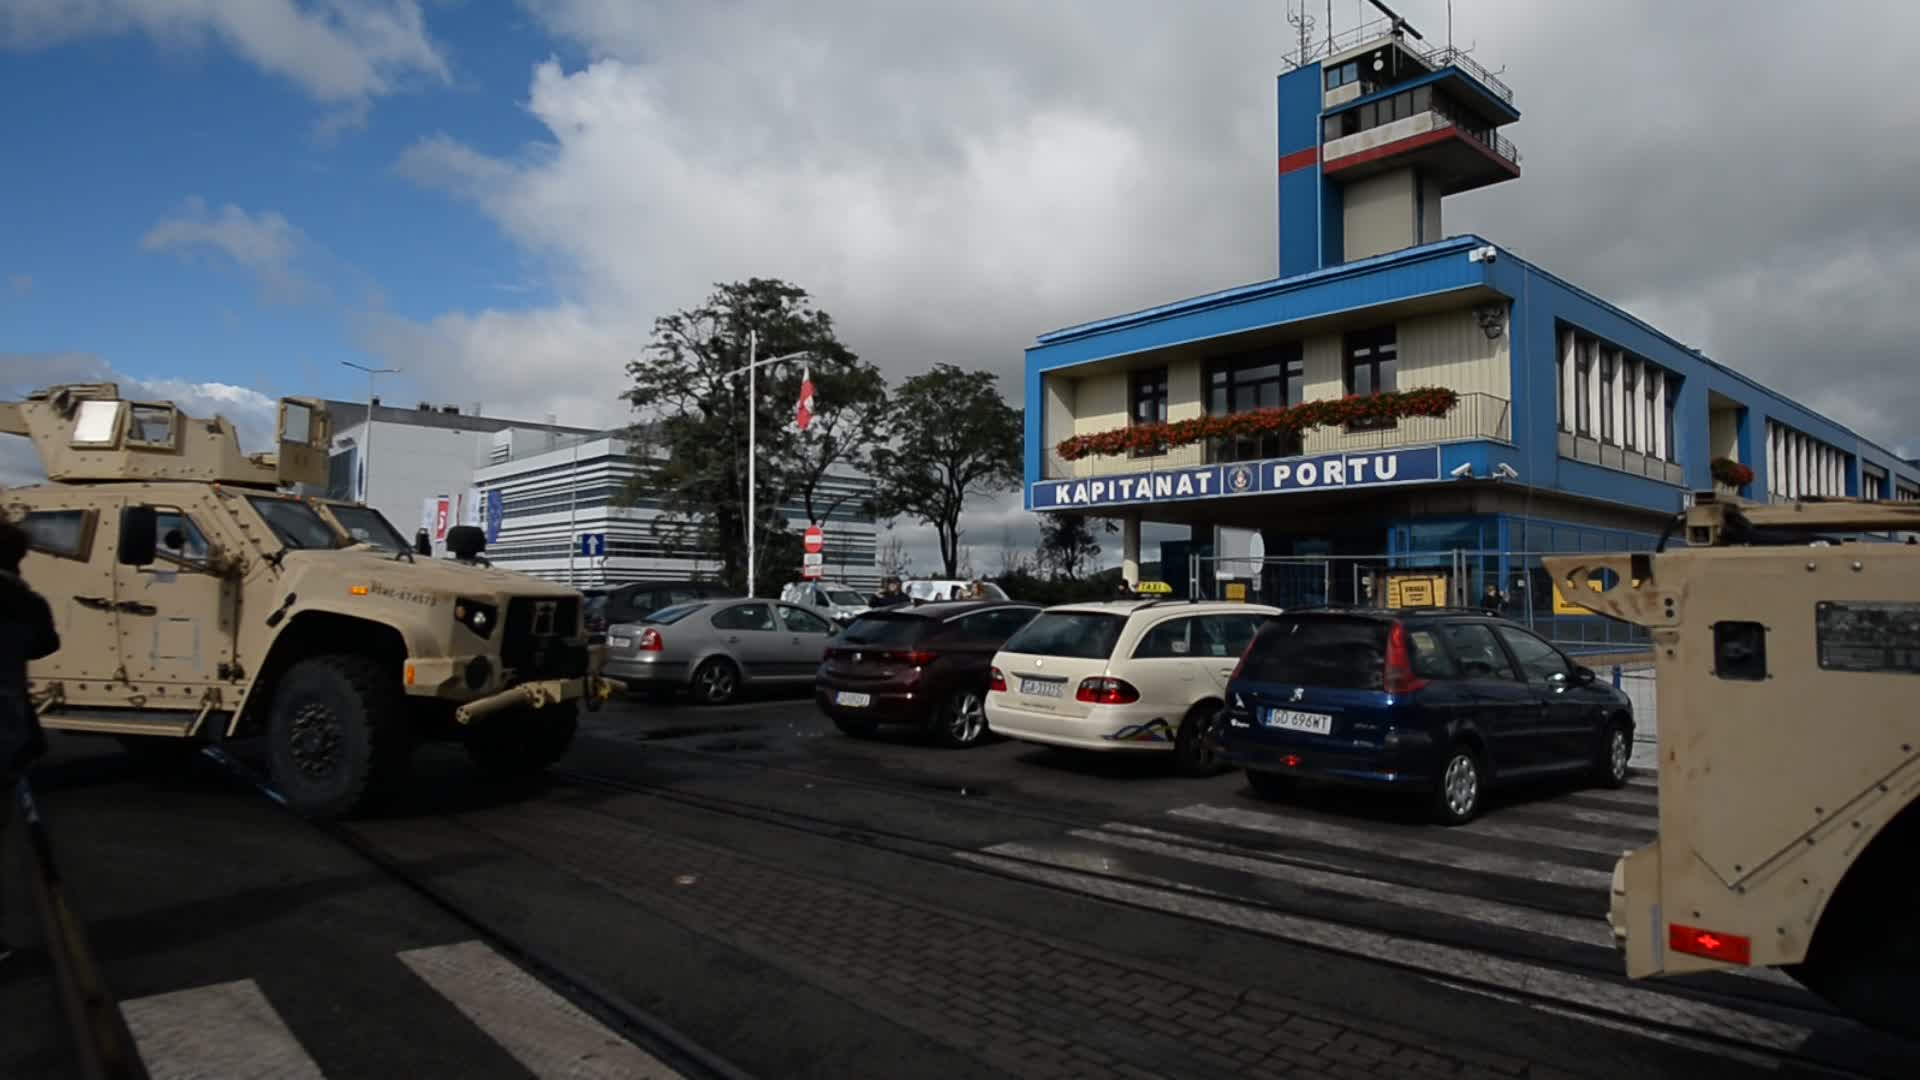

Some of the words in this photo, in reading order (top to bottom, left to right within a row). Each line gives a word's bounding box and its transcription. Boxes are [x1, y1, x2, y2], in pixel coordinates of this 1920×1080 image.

[1055, 471, 1213, 504] KAPITANAT
[1273, 454, 1398, 488] PORTU
[1140, 583, 1163, 591] TAXI
[1273, 710, 1290, 725] GD
